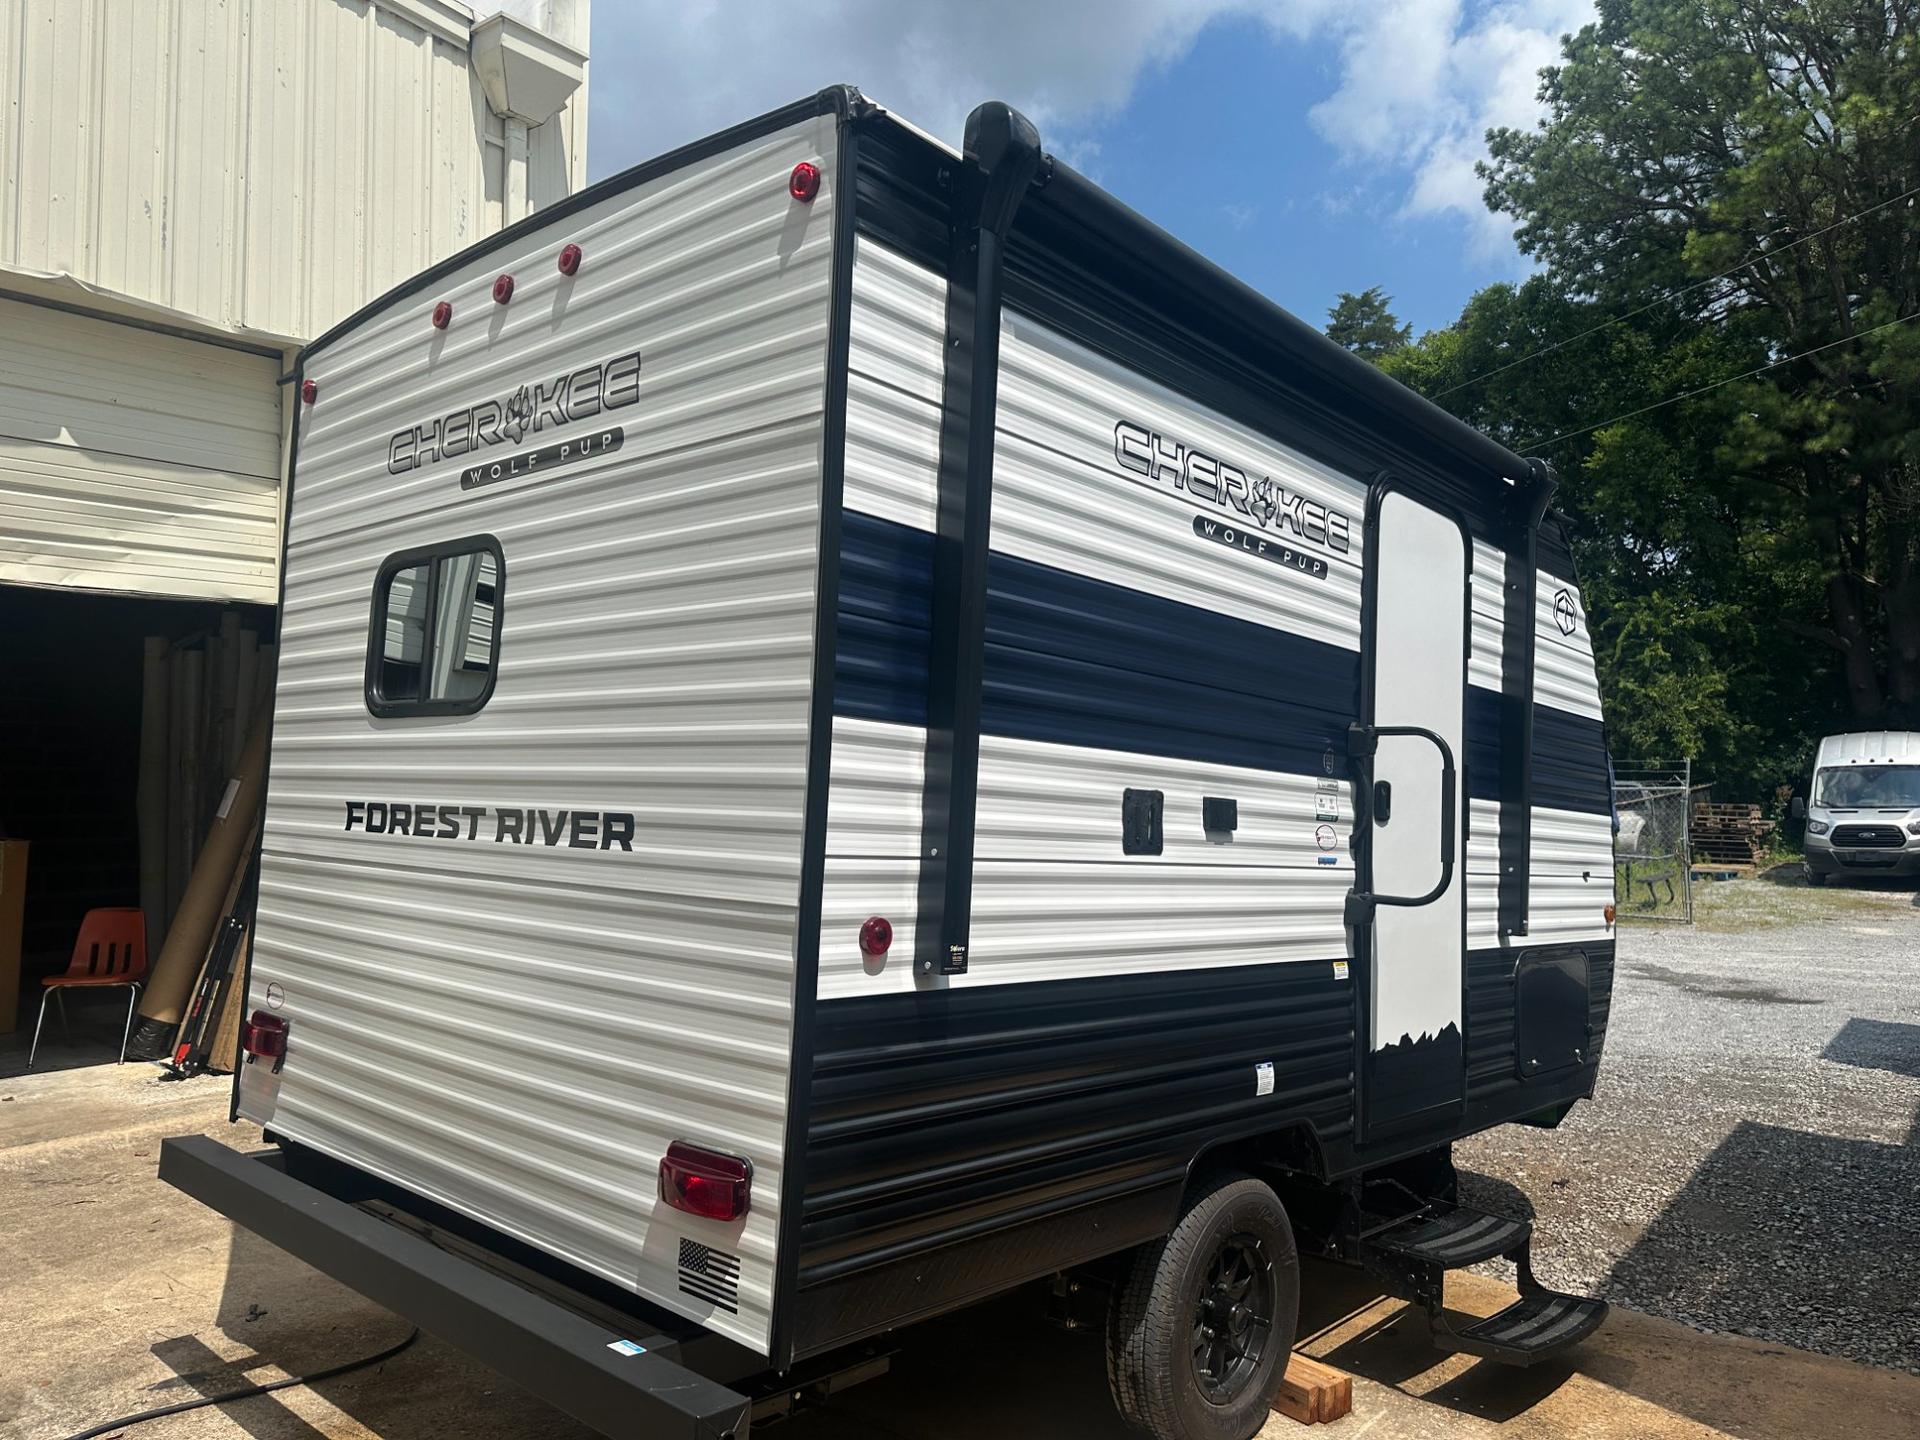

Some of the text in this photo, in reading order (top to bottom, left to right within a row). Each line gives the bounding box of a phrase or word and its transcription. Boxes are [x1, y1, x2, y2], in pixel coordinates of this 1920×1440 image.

[470, 433, 612, 483] WOLF PUP
[1204, 521, 1321, 573] WOLF PUP
[344, 801, 635, 851] FOREST RIVER
